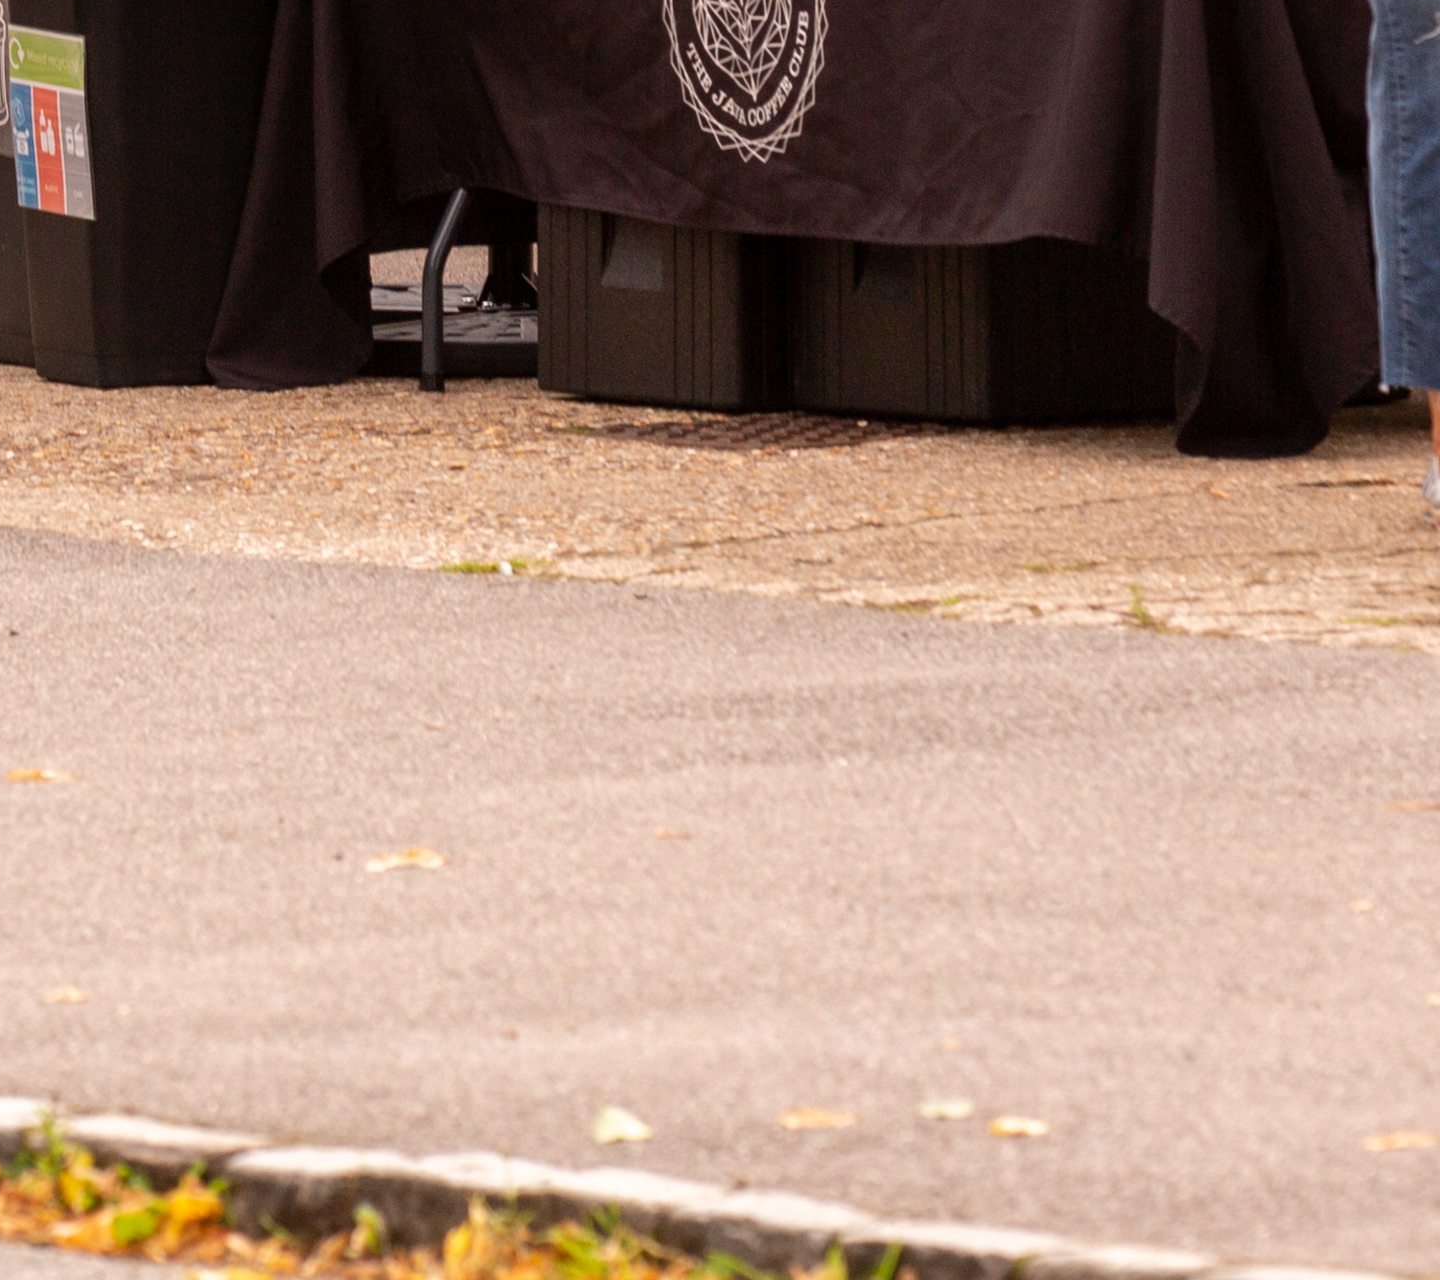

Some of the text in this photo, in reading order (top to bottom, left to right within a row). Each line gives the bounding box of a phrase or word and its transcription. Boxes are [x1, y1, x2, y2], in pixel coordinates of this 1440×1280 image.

[685, 10, 810, 127] THE JAVA COFFEE CLUB
